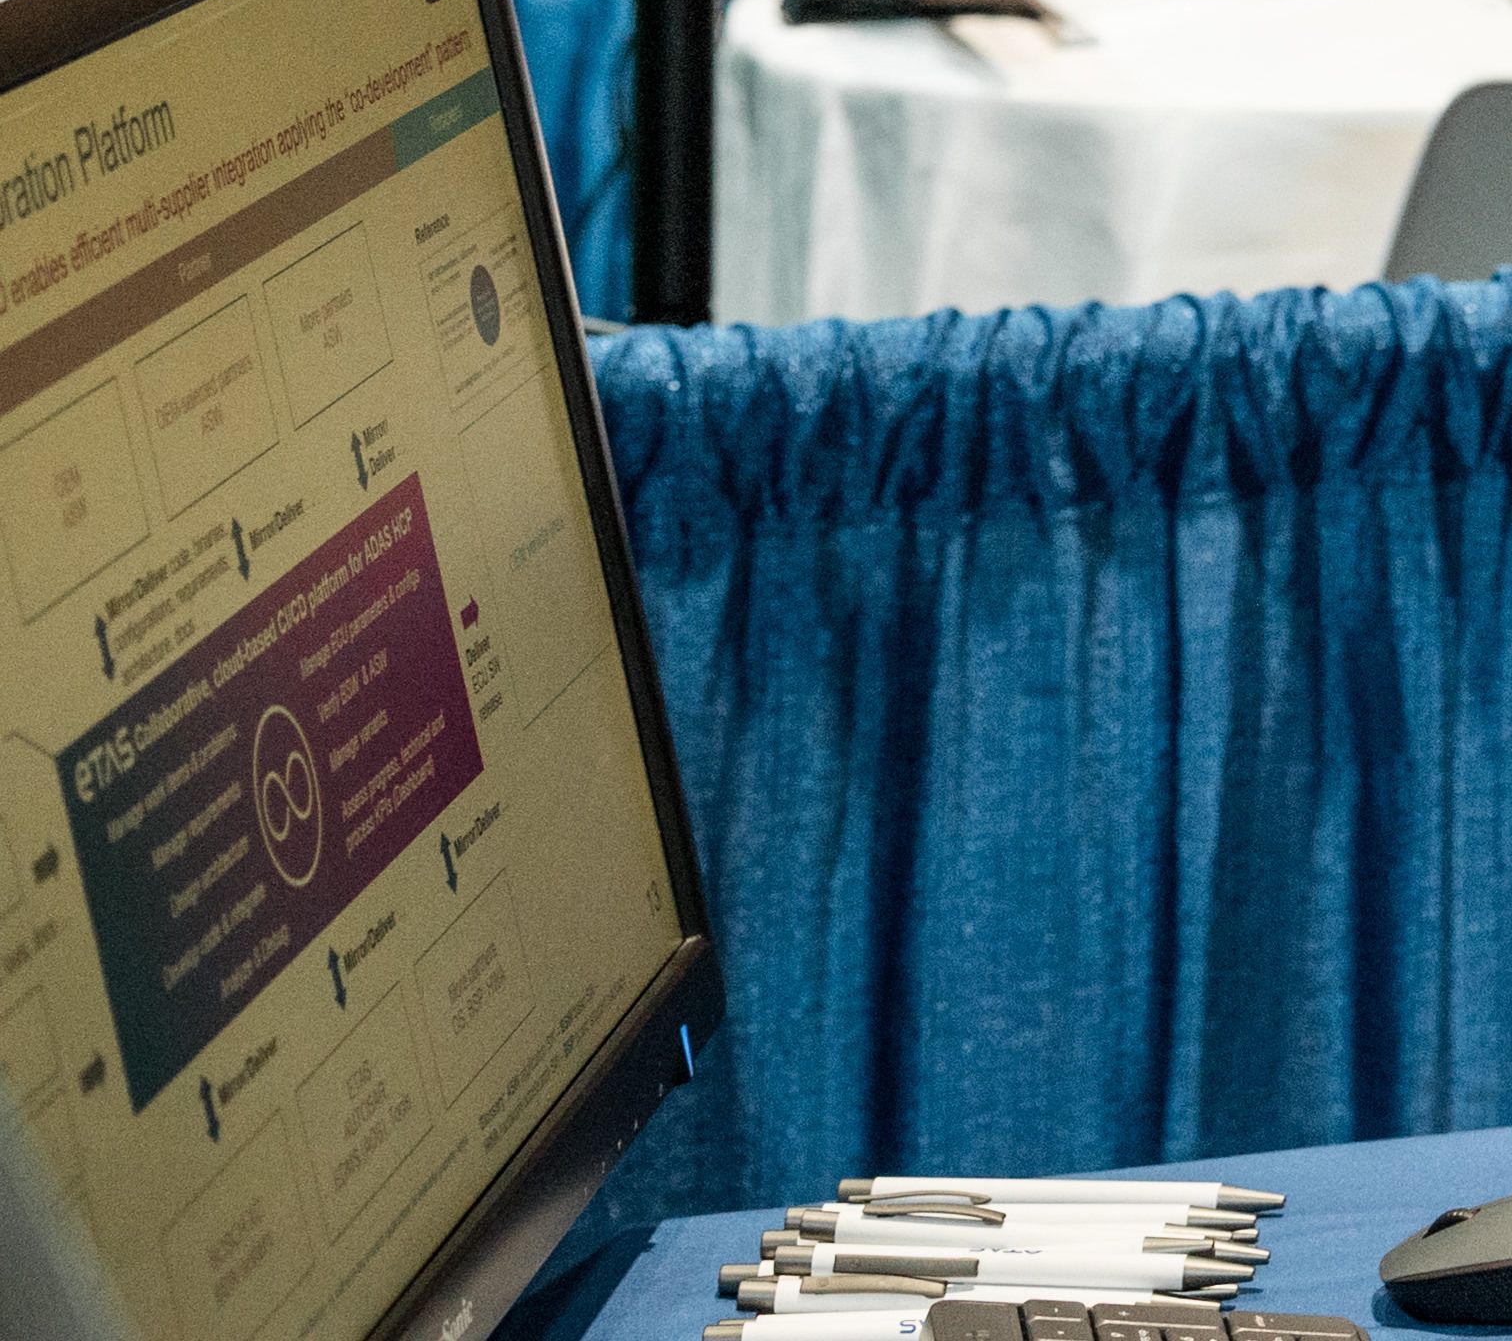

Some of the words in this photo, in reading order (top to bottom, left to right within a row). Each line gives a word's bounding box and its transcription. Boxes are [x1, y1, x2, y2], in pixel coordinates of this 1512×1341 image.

[71, 93, 177, 186] Platform
[208, 137, 278, 199] integration
[274, 102, 328, 162] applying
[323, 91, 346, 129] the
[210, 616, 278, 689] cloud-based
[305, 565, 351, 620] platform
[346, 543, 365, 577] for
[361, 521, 394, 564] ADAS
